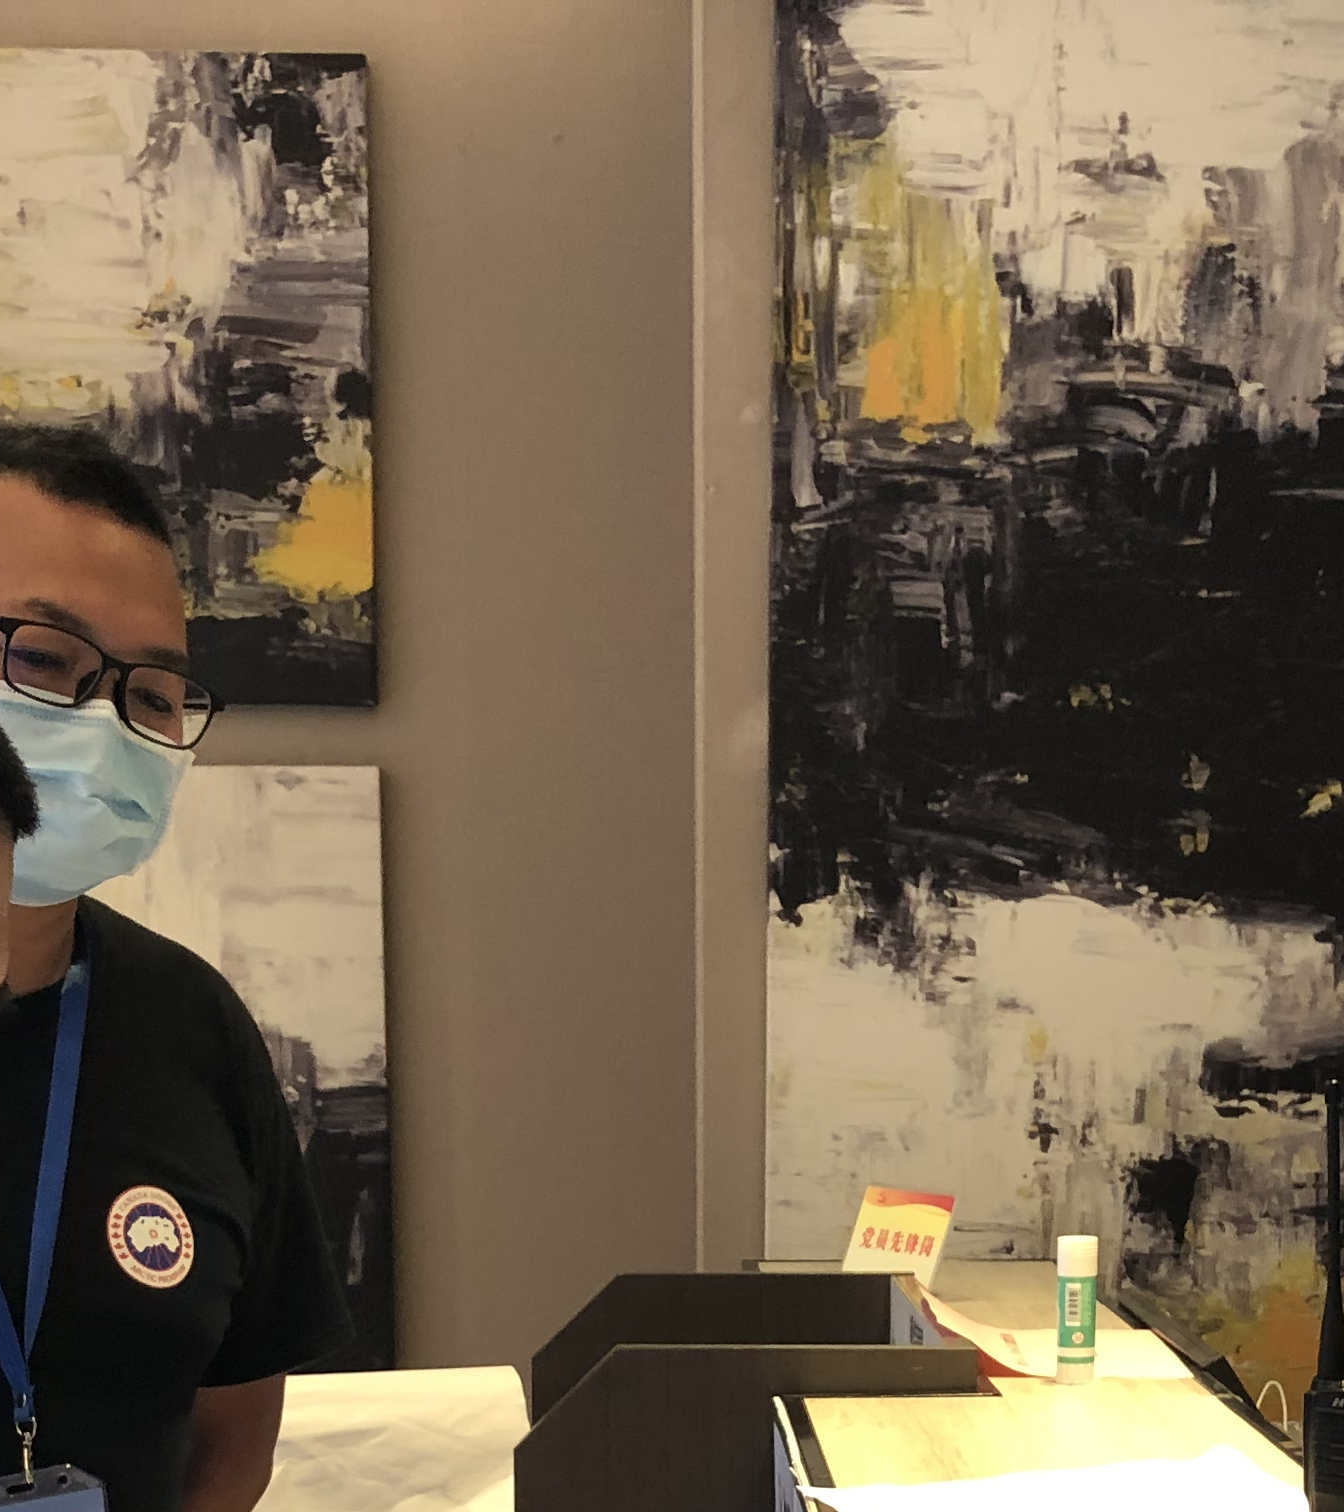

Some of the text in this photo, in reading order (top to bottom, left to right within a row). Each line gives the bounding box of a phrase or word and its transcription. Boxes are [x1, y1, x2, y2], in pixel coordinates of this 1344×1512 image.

[859, 1226, 935, 1257] 党员先锋岗
